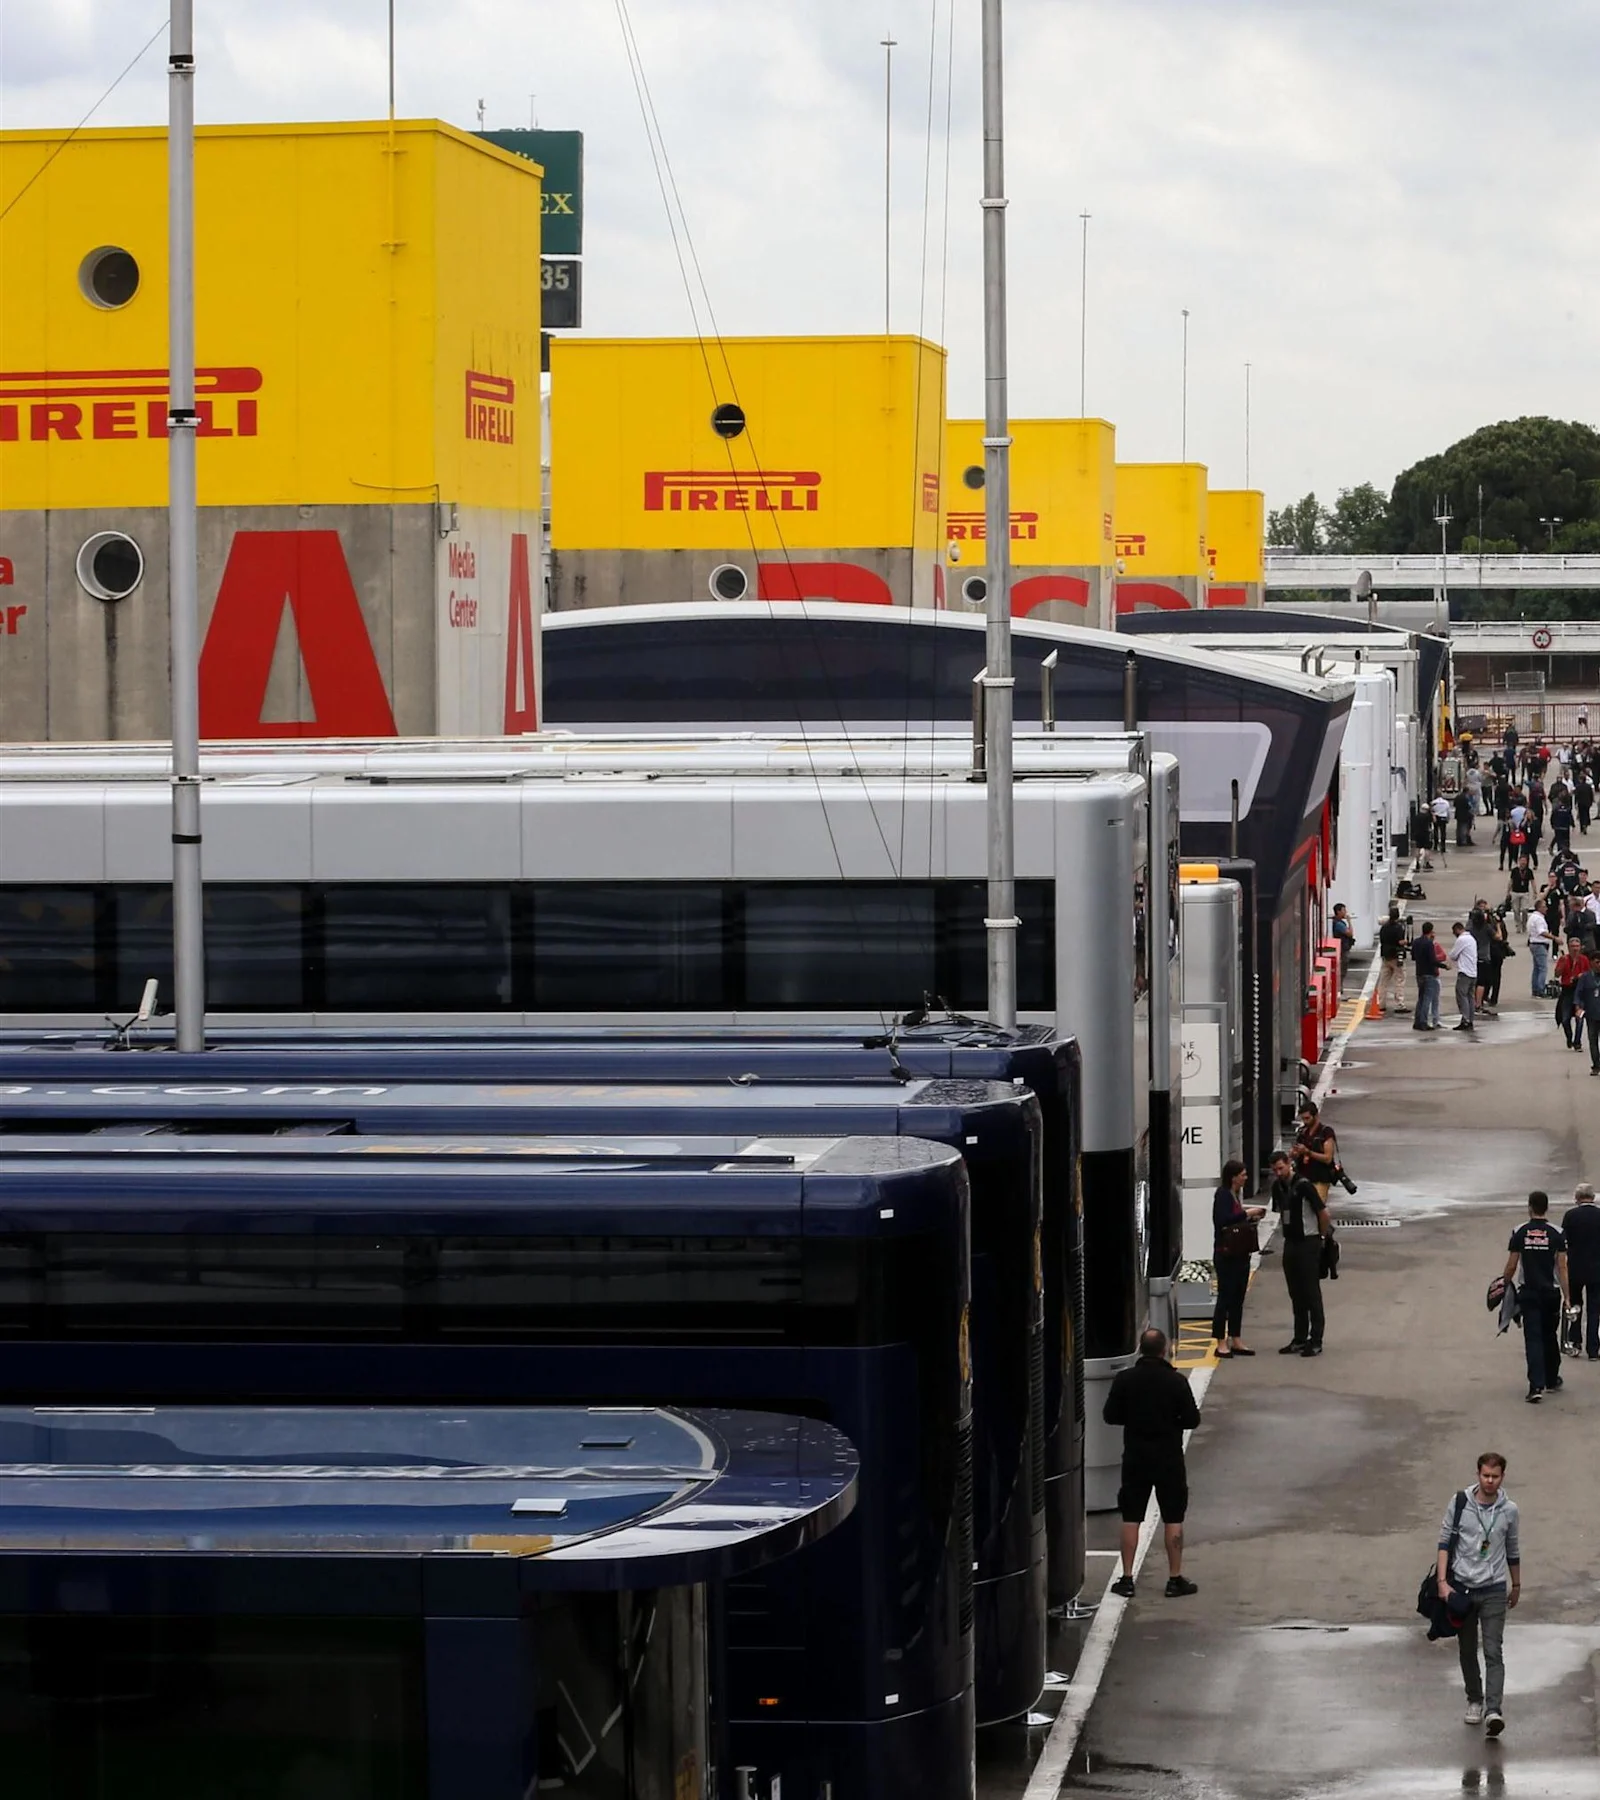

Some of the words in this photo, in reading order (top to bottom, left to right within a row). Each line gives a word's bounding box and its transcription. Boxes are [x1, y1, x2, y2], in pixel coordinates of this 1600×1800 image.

[465, 370, 515, 445] PIRELLI
[644, 471, 822, 511] PIRELLI
[449, 541, 476, 580] Media
[449, 591, 478, 628] Center
